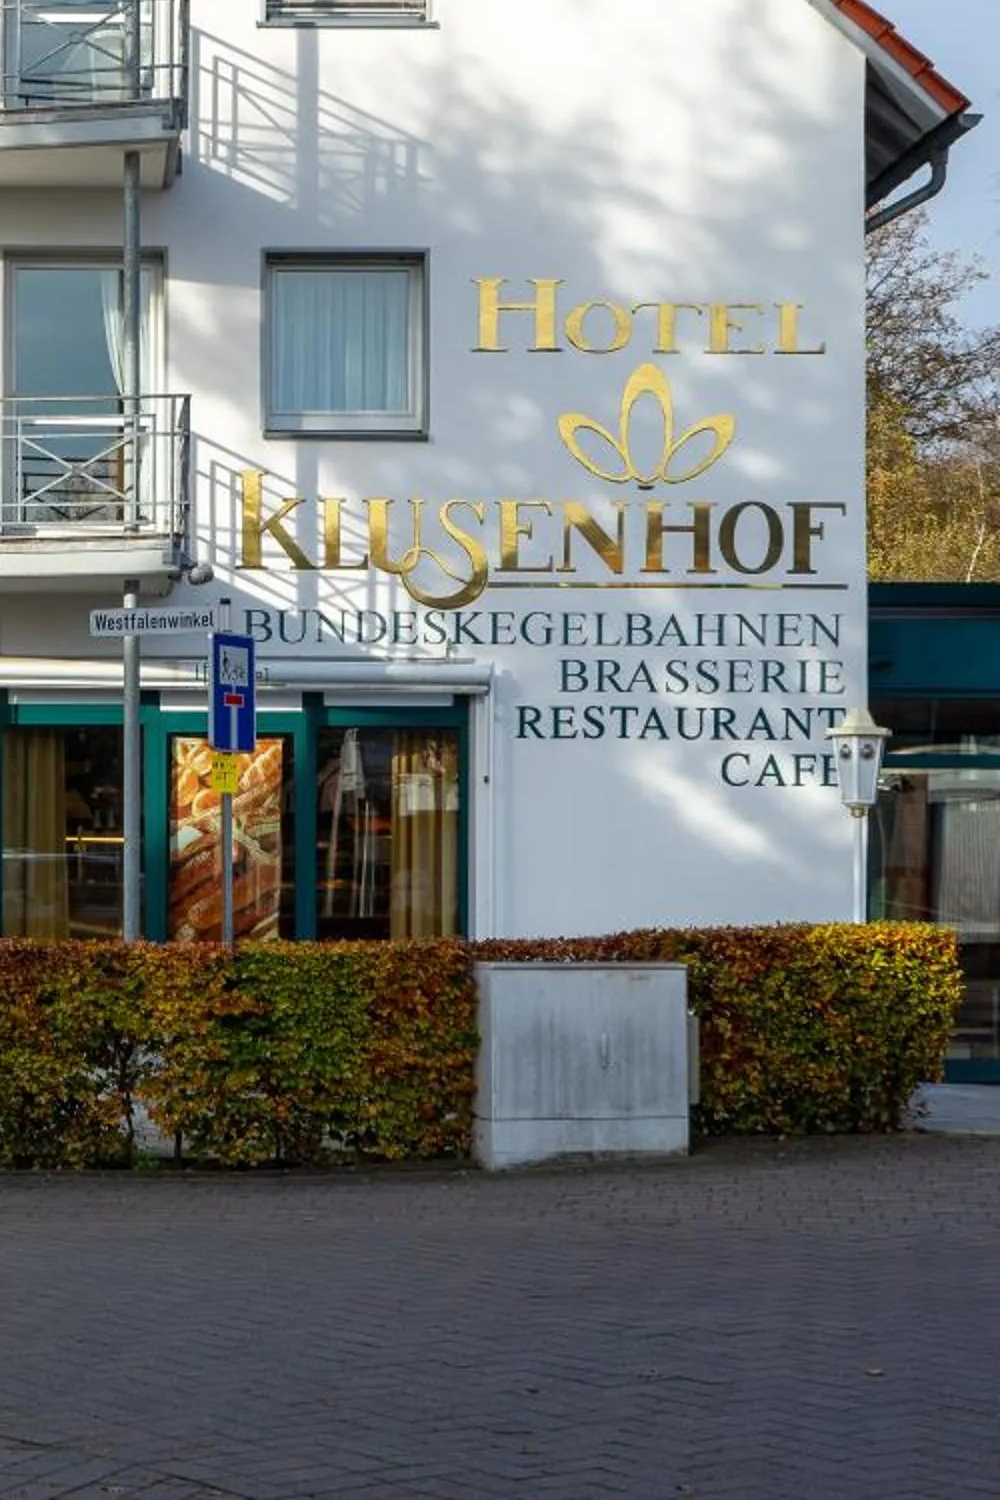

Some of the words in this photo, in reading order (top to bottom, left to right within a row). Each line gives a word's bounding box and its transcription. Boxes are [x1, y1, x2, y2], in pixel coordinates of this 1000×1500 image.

[471, 277, 825, 354] HOTEL
[234, 469, 848, 609] KLUSENHOF
[95, 610, 214, 631] Westfalenwinkel
[245, 608, 841, 647] BUNDESKEGELBAHNEN
[560, 658, 846, 695] BRASSERIE
[516, 706, 846, 741] RESTAURANT
